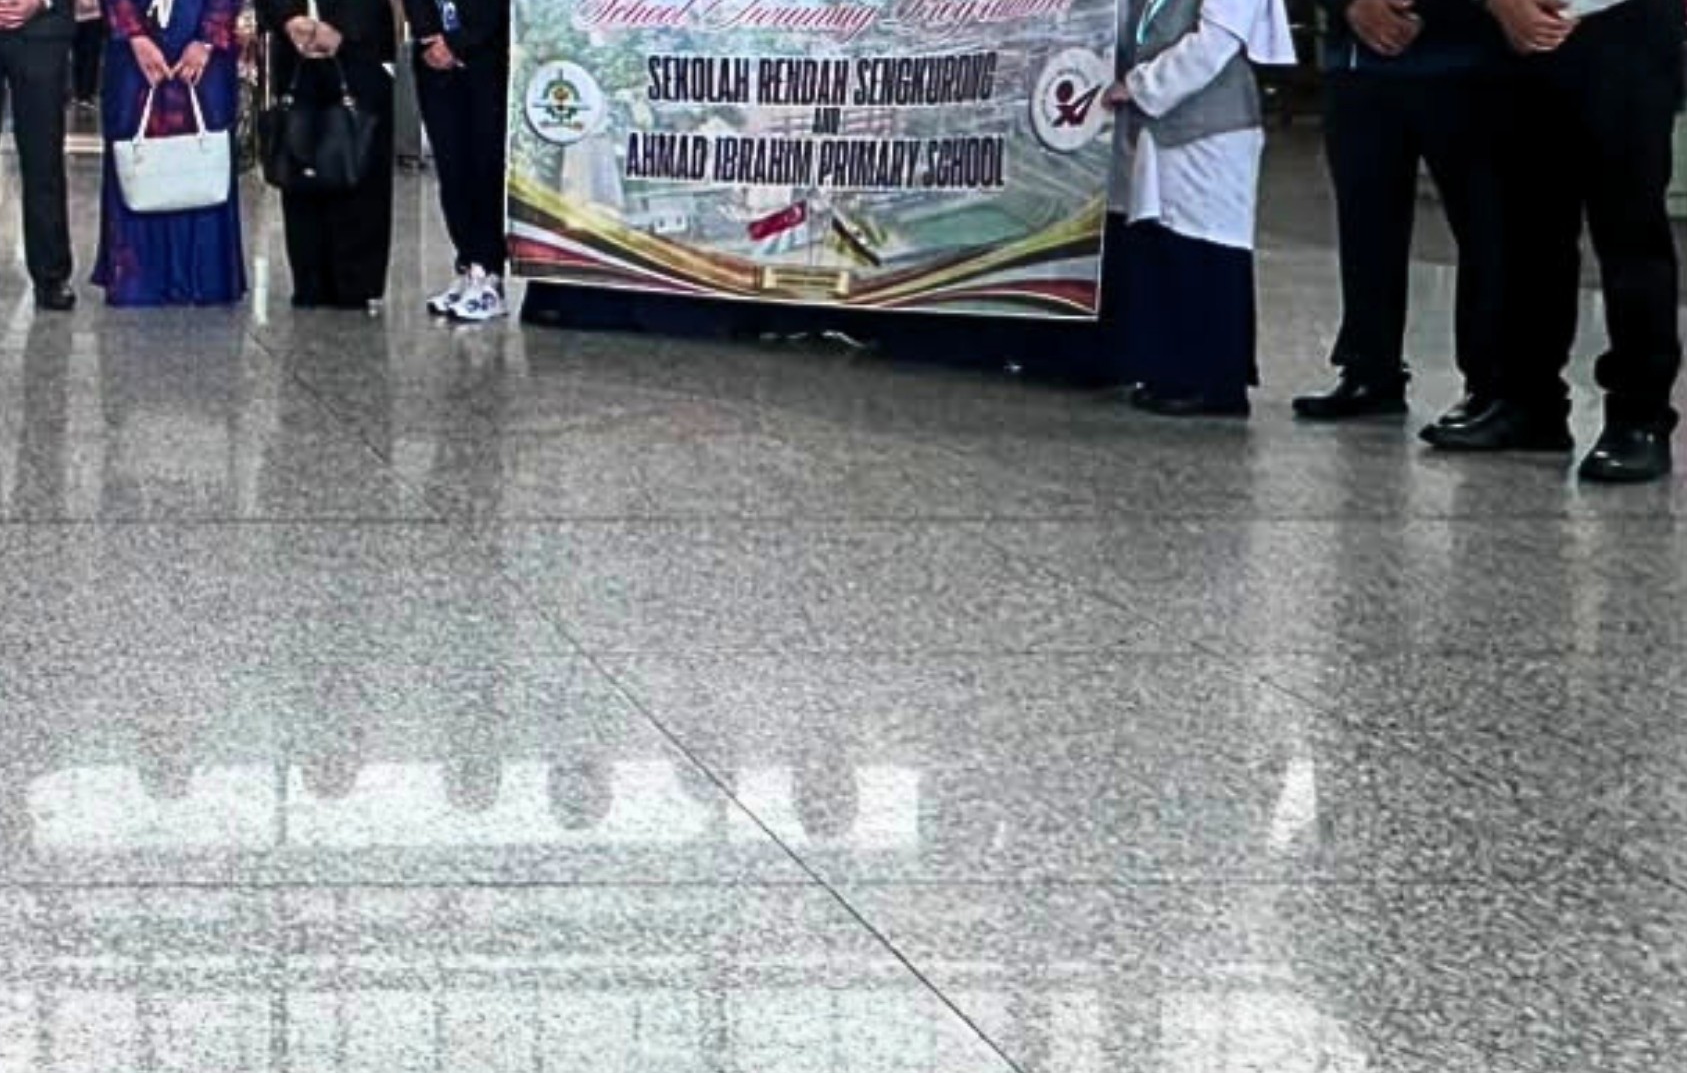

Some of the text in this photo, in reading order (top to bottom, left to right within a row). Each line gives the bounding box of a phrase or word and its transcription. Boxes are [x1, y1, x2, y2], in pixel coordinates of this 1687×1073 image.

[647, 55, 750, 104] SEKOLAH
[756, 58, 849, 106] RENDAH
[852, 51, 998, 106] SENGKURONG
[626, 132, 1006, 188] AHMAD IBRAHIM PRIMARY SCHOOL
